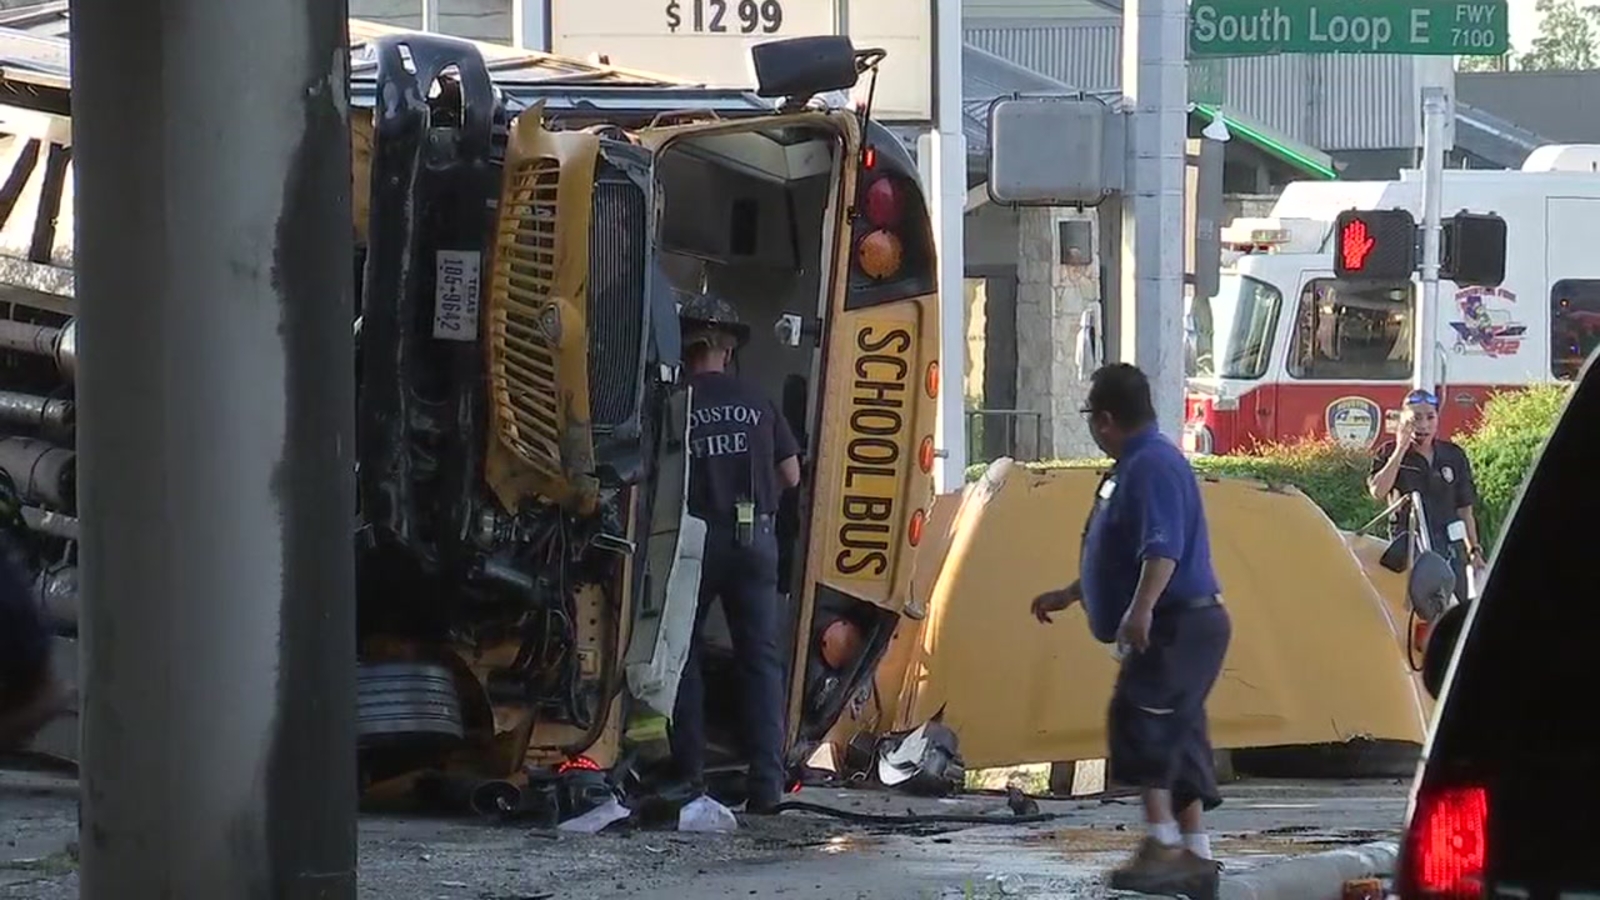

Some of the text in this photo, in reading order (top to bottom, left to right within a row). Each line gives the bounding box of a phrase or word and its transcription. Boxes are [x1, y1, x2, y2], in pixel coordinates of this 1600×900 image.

[666, 0, 681, 33] $
[738, 0, 782, 33] 99
[1195, 6, 1430, 50] South Loop E
[1456, 4, 1496, 23] FWY
[1451, 28, 1495, 47] 7100
[466, 276, 477, 314] TEXAS
[689, 404, 762, 429] OUSTON
[835, 326, 911, 576] SCHOOL BUS
